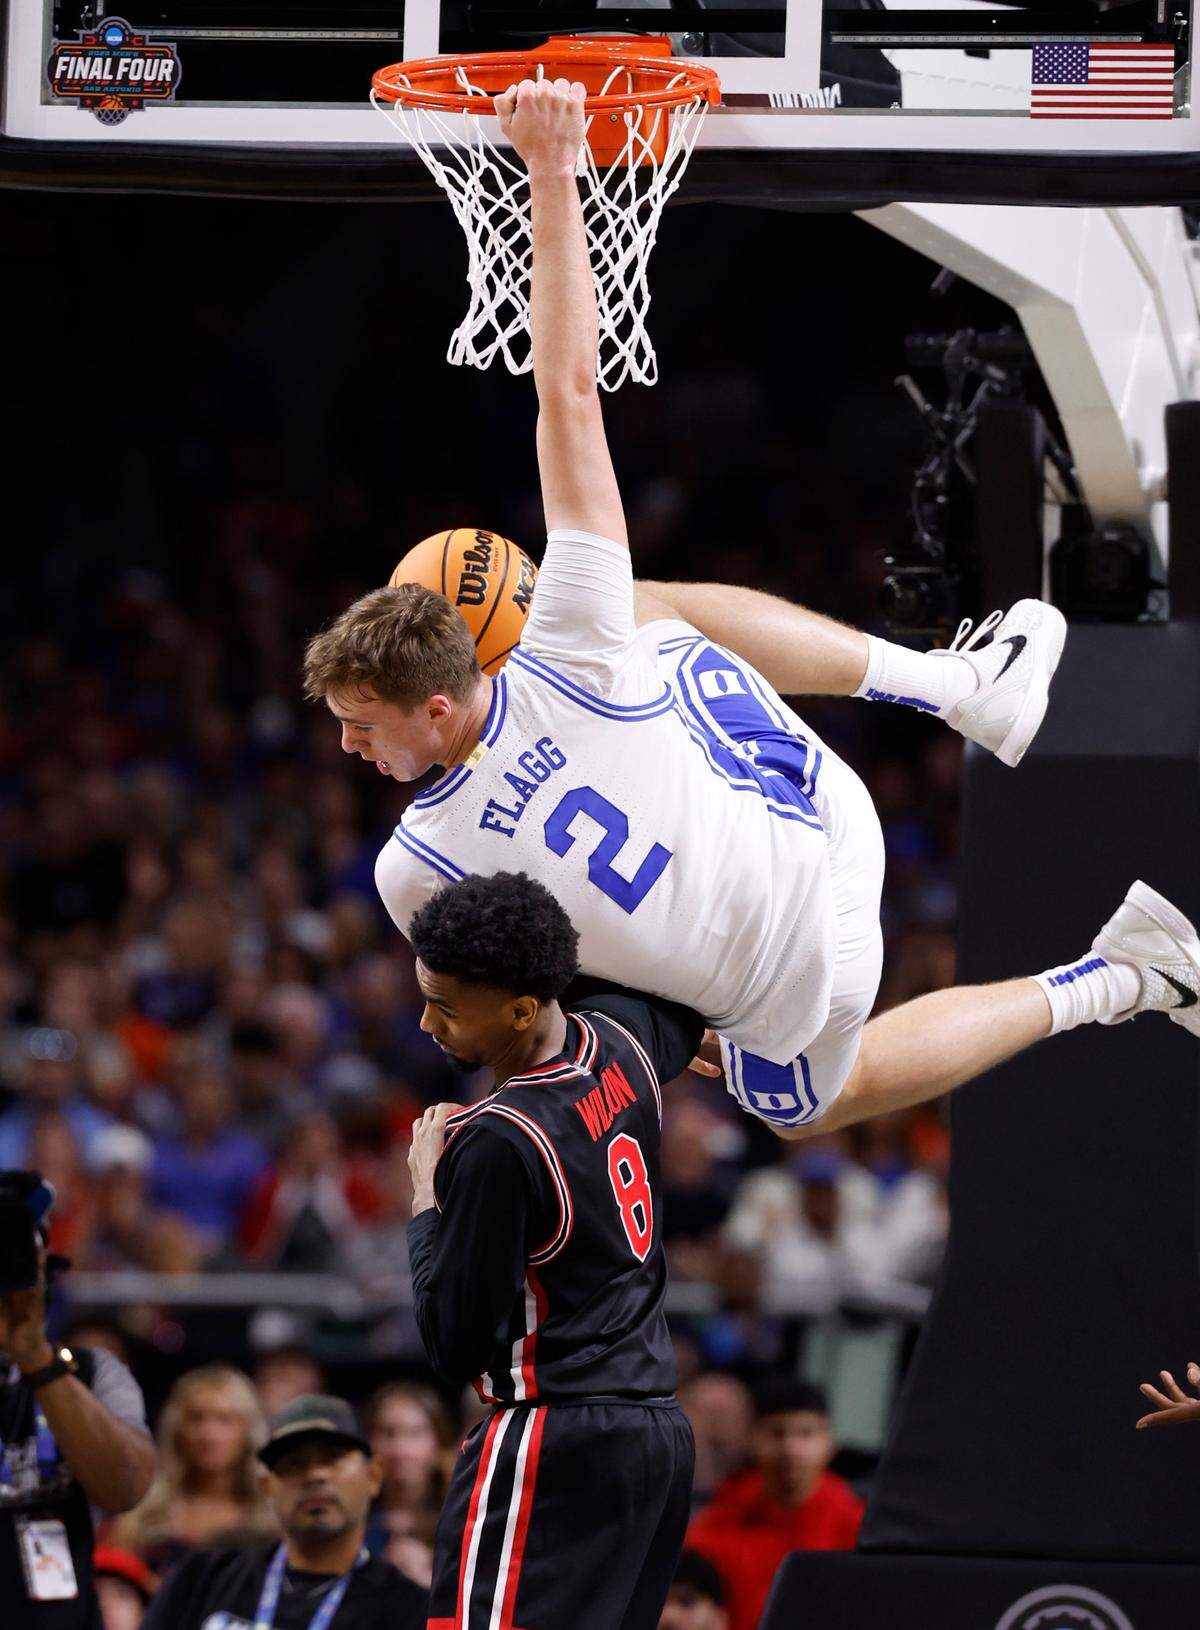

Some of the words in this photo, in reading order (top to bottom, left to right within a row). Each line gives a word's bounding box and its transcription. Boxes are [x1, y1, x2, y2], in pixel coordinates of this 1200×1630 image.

[55, 56, 113, 80] FINAL
[115, 57, 175, 81] FOUR
[479, 736, 567, 839] FLAGG
[543, 785, 674, 915] 2
[607, 1132, 653, 1262] 8
